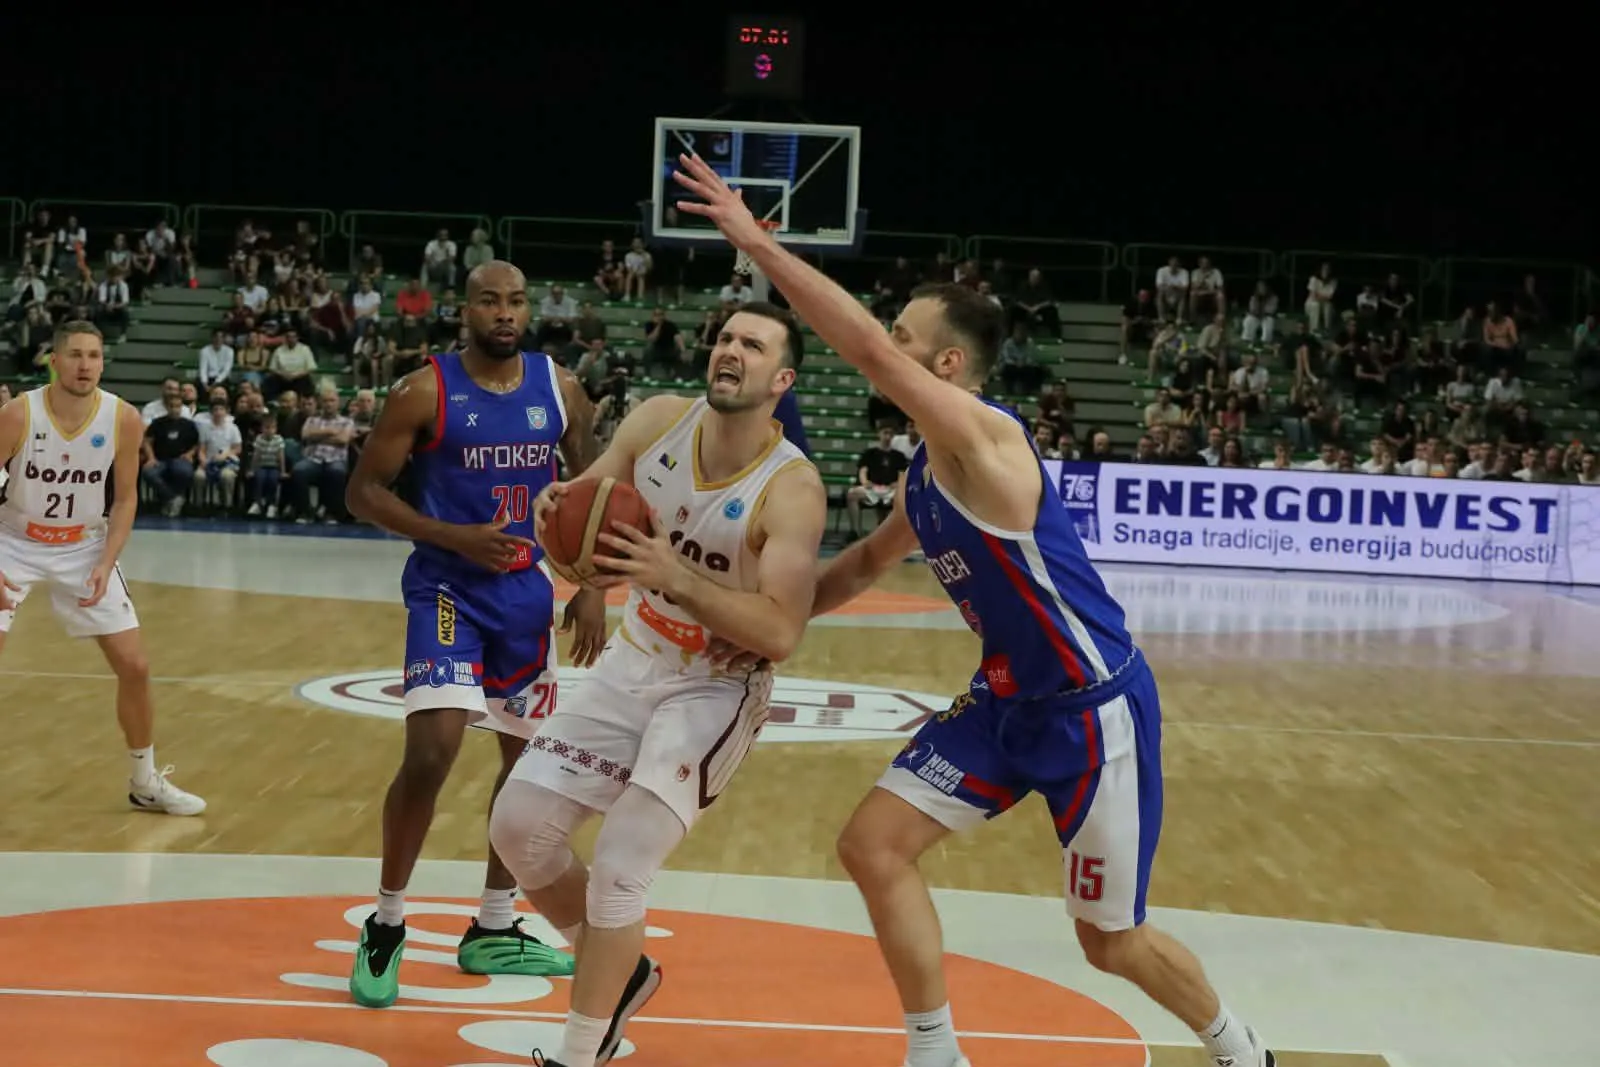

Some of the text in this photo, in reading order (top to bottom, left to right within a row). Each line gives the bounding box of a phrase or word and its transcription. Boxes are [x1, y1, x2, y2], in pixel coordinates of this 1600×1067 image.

[25, 461, 102, 484] bosna
[44, 493, 75, 519] 21
[491, 485, 528, 523] 20
[1114, 477, 1558, 534] ENERGOINVEST
[1113, 523, 1558, 564] Snaga tradicije, energija budućnosti!
[916, 764, 957, 794] BANKA
[926, 753, 965, 785] NOVA
[1069, 851, 1105, 902] 15
